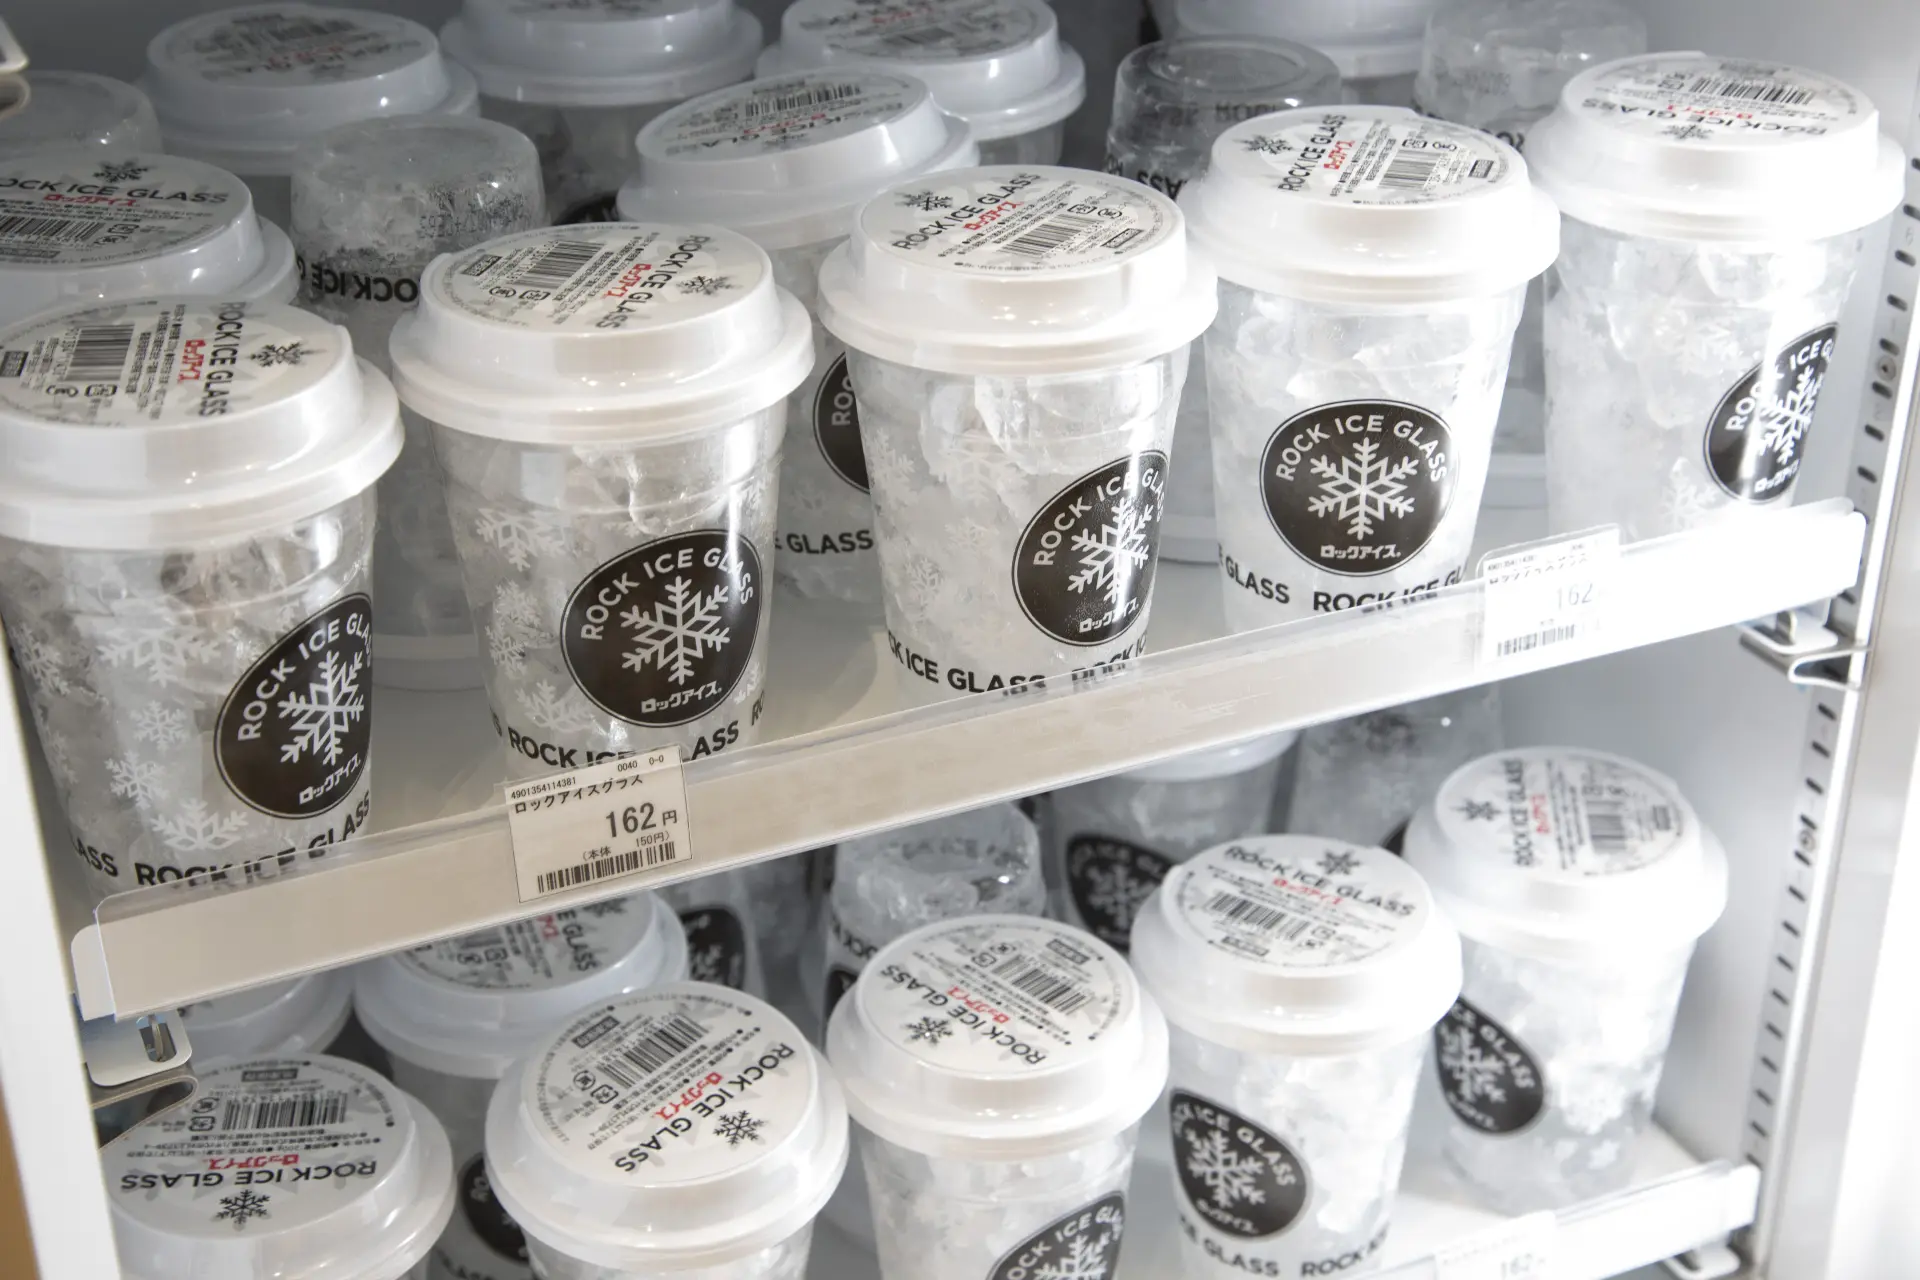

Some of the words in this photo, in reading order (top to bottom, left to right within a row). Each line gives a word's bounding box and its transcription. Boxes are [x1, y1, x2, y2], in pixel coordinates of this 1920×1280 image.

[1311, 113, 1347, 145] GLASS
[1300, 146, 1326, 166] ICE
[66, 183, 119, 196] ICE
[126, 187, 229, 204] GLASS
[1277, 162, 1311, 192] ROCK
[891, 220, 952, 250] ROCK
[944, 204, 984, 223] ICE
[980, 172, 1041, 206] GLASS
[660, 234, 711, 270] ROCK
[639, 269, 678, 290] ICE
[213, 301, 247, 341] ROCK
[595, 290, 654, 329] GLASS
[208, 343, 238, 367] ICE
[1789, 340, 1822, 371] ICE
[199, 368, 235, 418] GLASS
[1276, 423, 1331, 482] ROCK
[1334, 413, 1385, 435] ICE
[1393, 419, 1448, 483] GLASS
[1032, 498, 1094, 567] ROCK
[1096, 474, 1132, 502] ICE
[785, 529, 874, 555] GLASS
[1319, 543, 1400, 561] ロックアイス
[581, 571, 641, 640] ROCK
[642, 547, 695, 580] ICE
[702, 546, 755, 605] GLASS
[1225, 556, 1291, 605] GLASS
[1313, 590, 1396, 614] ROCK
[238, 657, 296, 742] ROCK
[298, 618, 341, 661] ICE
[905, 646, 940, 684] ICE
[640, 680, 722, 714] ロックアイス
[507, 726, 578, 769] ROCK
[299, 752, 362, 805] ロックアイス
[511, 776, 577, 800] 4901354114381
[617, 759, 639, 773] 0040
[514, 774, 644, 815] ロックアイスグラス
[134, 861, 233, 888] ROCK
[308, 788, 371, 858] GLASS
[605, 802, 658, 838] 162
[661, 809, 678, 827] 円
[1224, 845, 1293, 876] ROCK
[1293, 869, 1333, 888] ICE
[1336, 884, 1417, 917] GLASS
[880, 963, 949, 1008] GLASS
[946, 1003, 981, 1031] ICE
[982, 1025, 1049, 1066] ROCK
[727, 1041, 796, 1092] ROCK
[654, 1071, 724, 1121] ロックアイス
[690, 1088, 736, 1118] ICE
[207, 1153, 300, 1171] ロックアイス
[614, 1116, 693, 1173] GLASS
[1236, 1126, 1297, 1187] GLASS
[120, 1169, 224, 1191] GLASS
[234, 1169, 286, 1186] ICE
[296, 1160, 378, 1182] ROCK
[1054, 1212, 1093, 1243] ICE
[1203, 1237, 1281, 1278] GLASS
[1301, 1251, 1364, 1278] ROCK
